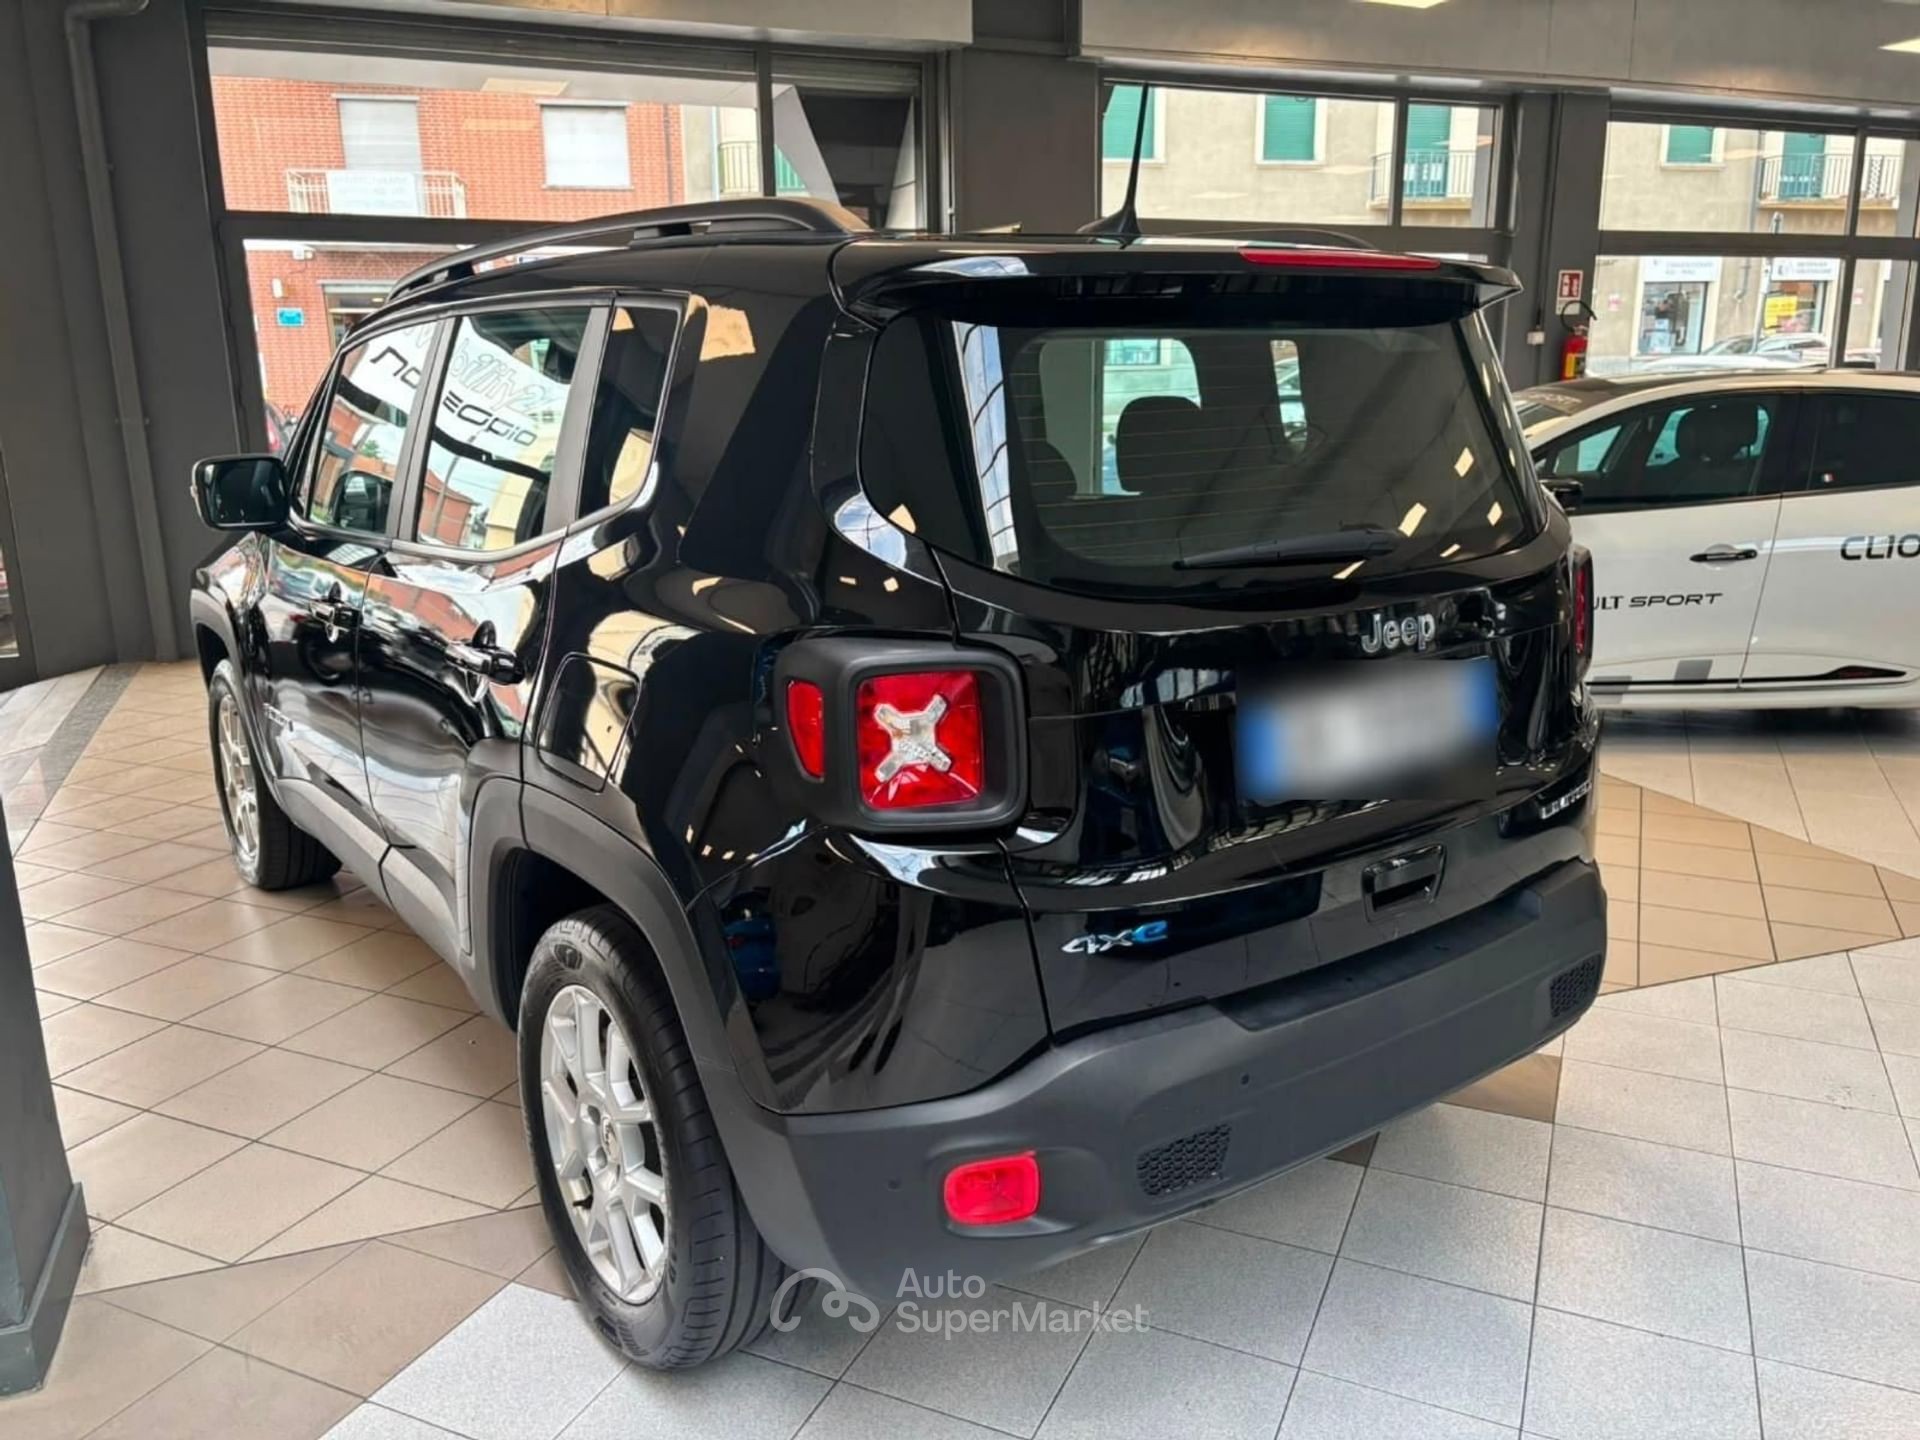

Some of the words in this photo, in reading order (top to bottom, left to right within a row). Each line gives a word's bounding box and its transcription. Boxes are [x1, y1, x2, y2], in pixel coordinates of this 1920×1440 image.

[1840, 533, 1920, 561] CLIO
[1628, 592, 1724, 608] SPORT
[1361, 613, 1436, 653] Jeep
